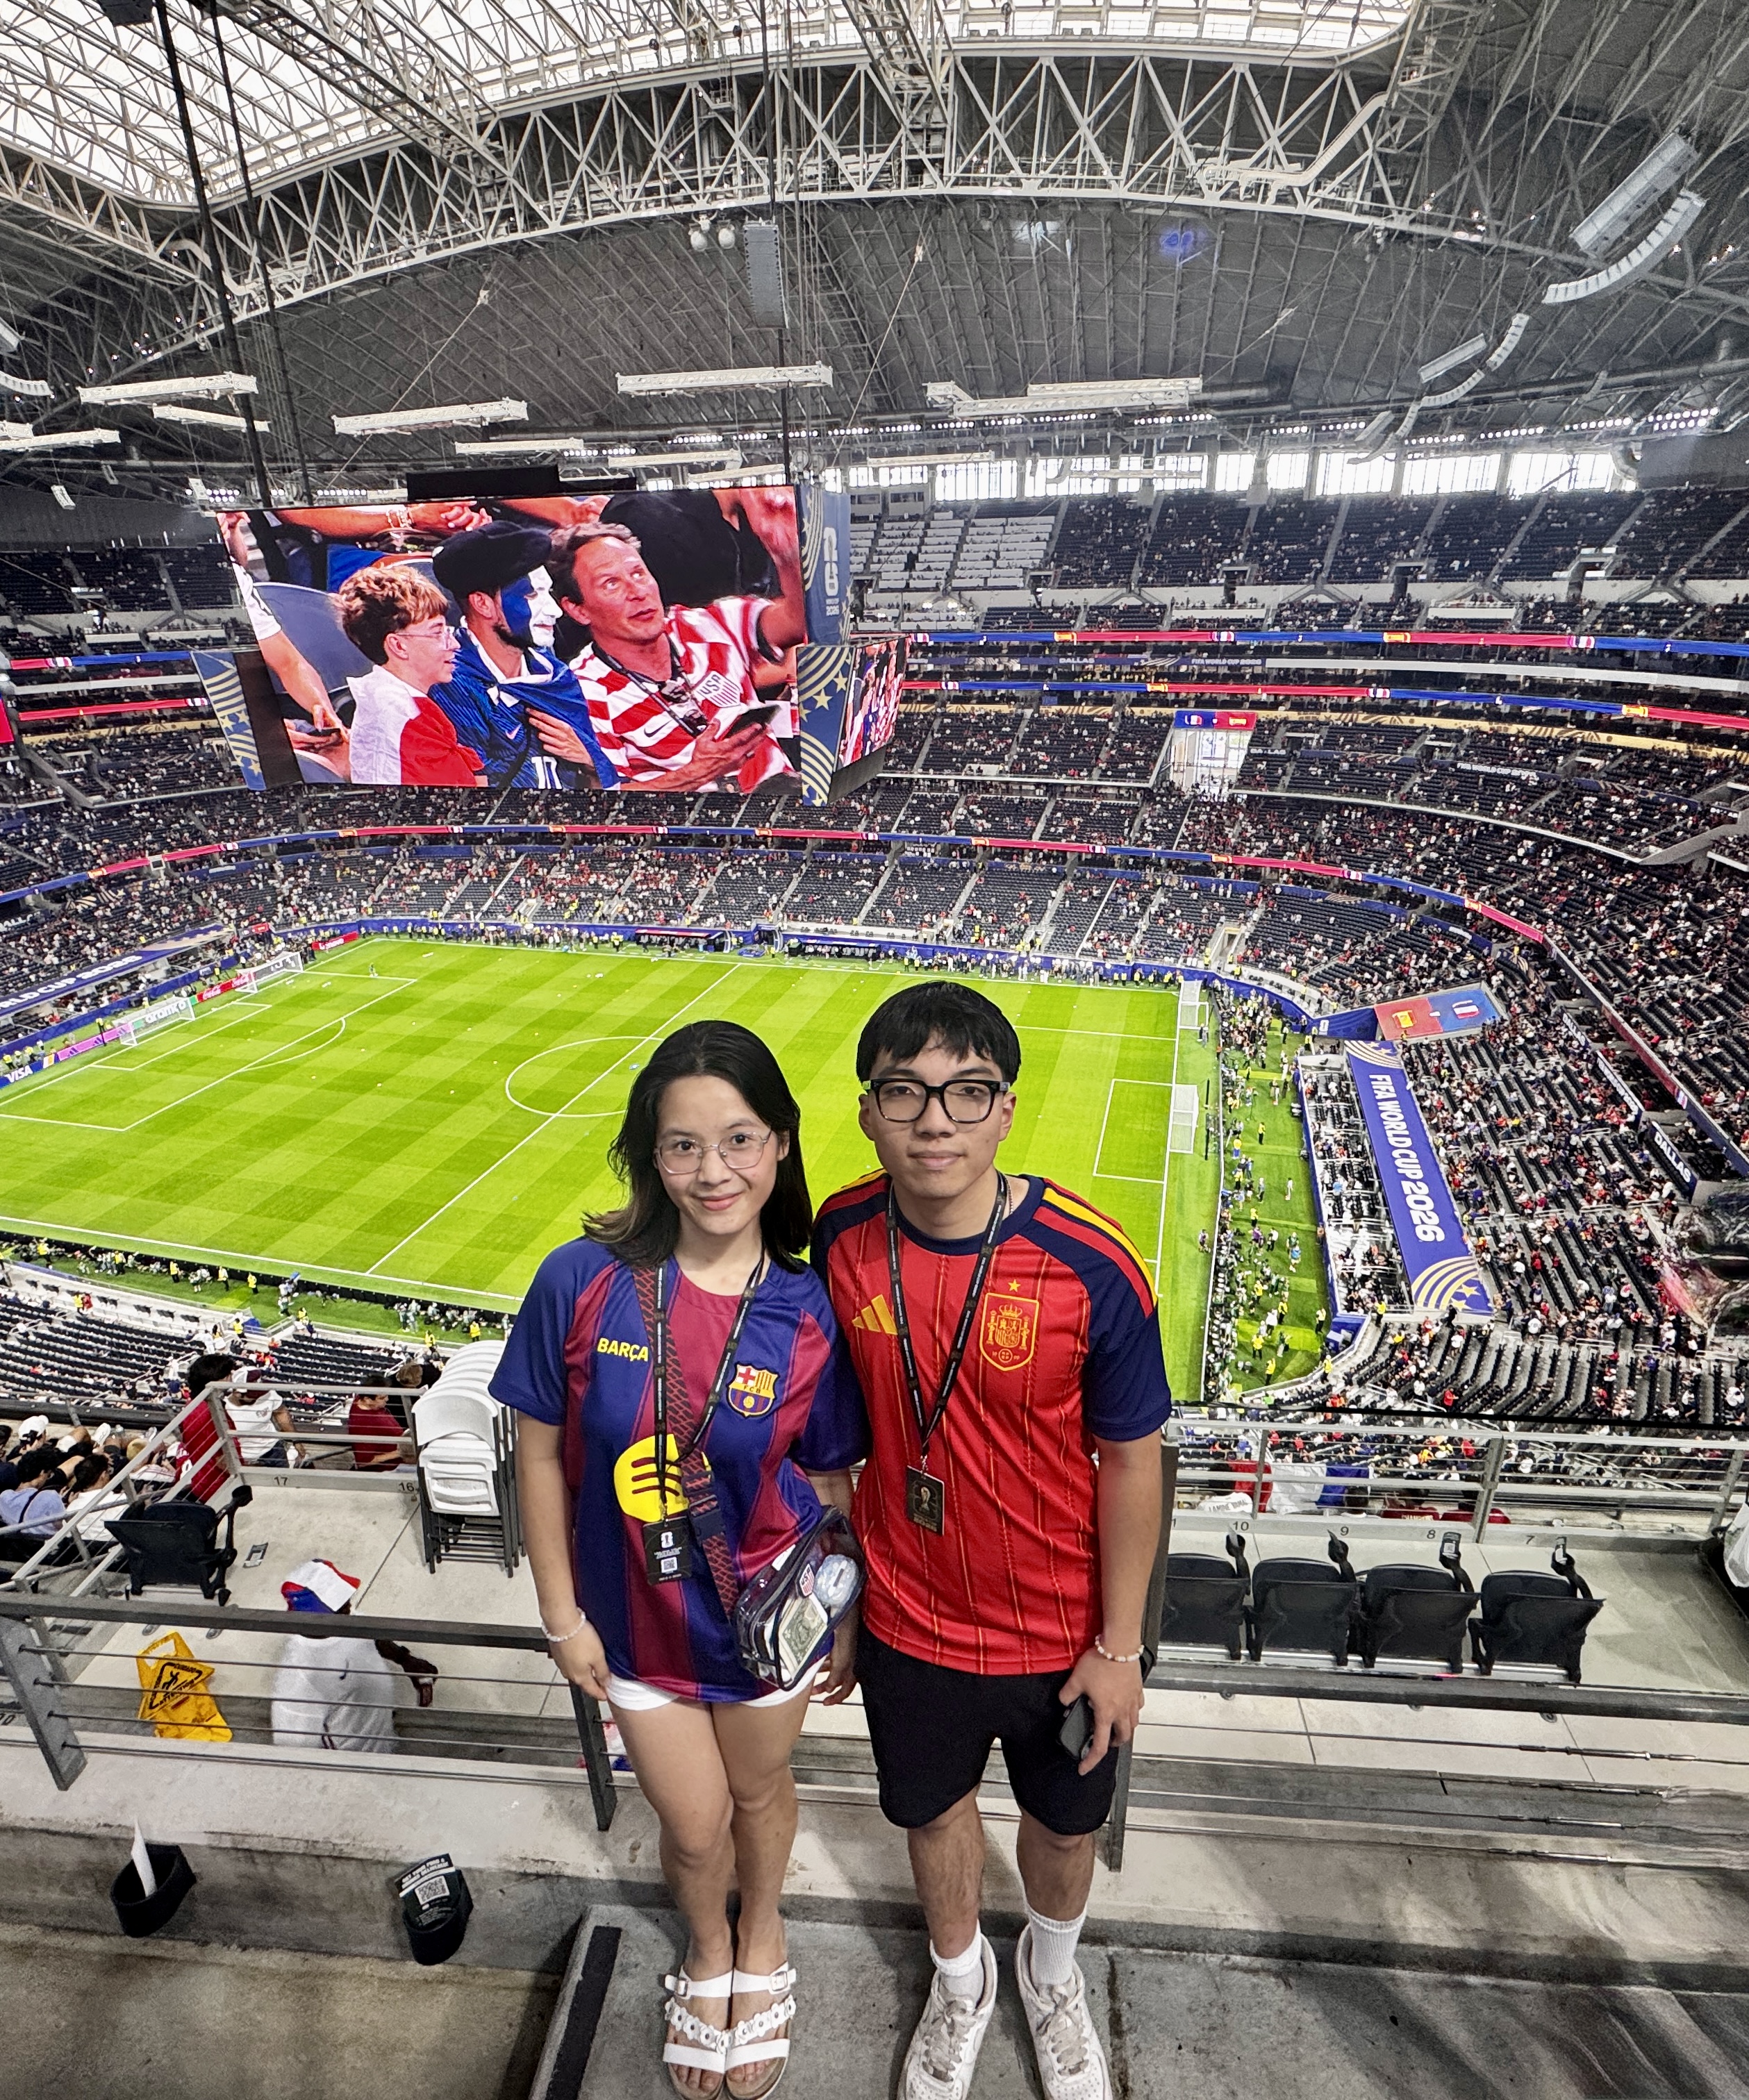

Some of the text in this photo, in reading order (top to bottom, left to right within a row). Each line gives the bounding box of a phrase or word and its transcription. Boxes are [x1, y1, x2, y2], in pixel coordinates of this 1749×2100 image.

[38, 977, 77, 993] CUP
[76, 955, 143, 980] 2026
[4, 1065, 33, 1083] VISA
[1368, 1074, 1445, 1242] FIFA WORLD CUP 2026
[1654, 1131, 1691, 1183] DALLAS
[597, 1337, 649, 1362] BARÇA
[274, 1476, 288, 1486] 17
[398, 1481, 415, 1492] 16
[1233, 1520, 1250, 1531] 10
[1340, 1526, 1350, 1536] 9
[1426, 1529, 1436, 1540] 8
[1525, 1535, 1536, 1544] 7
